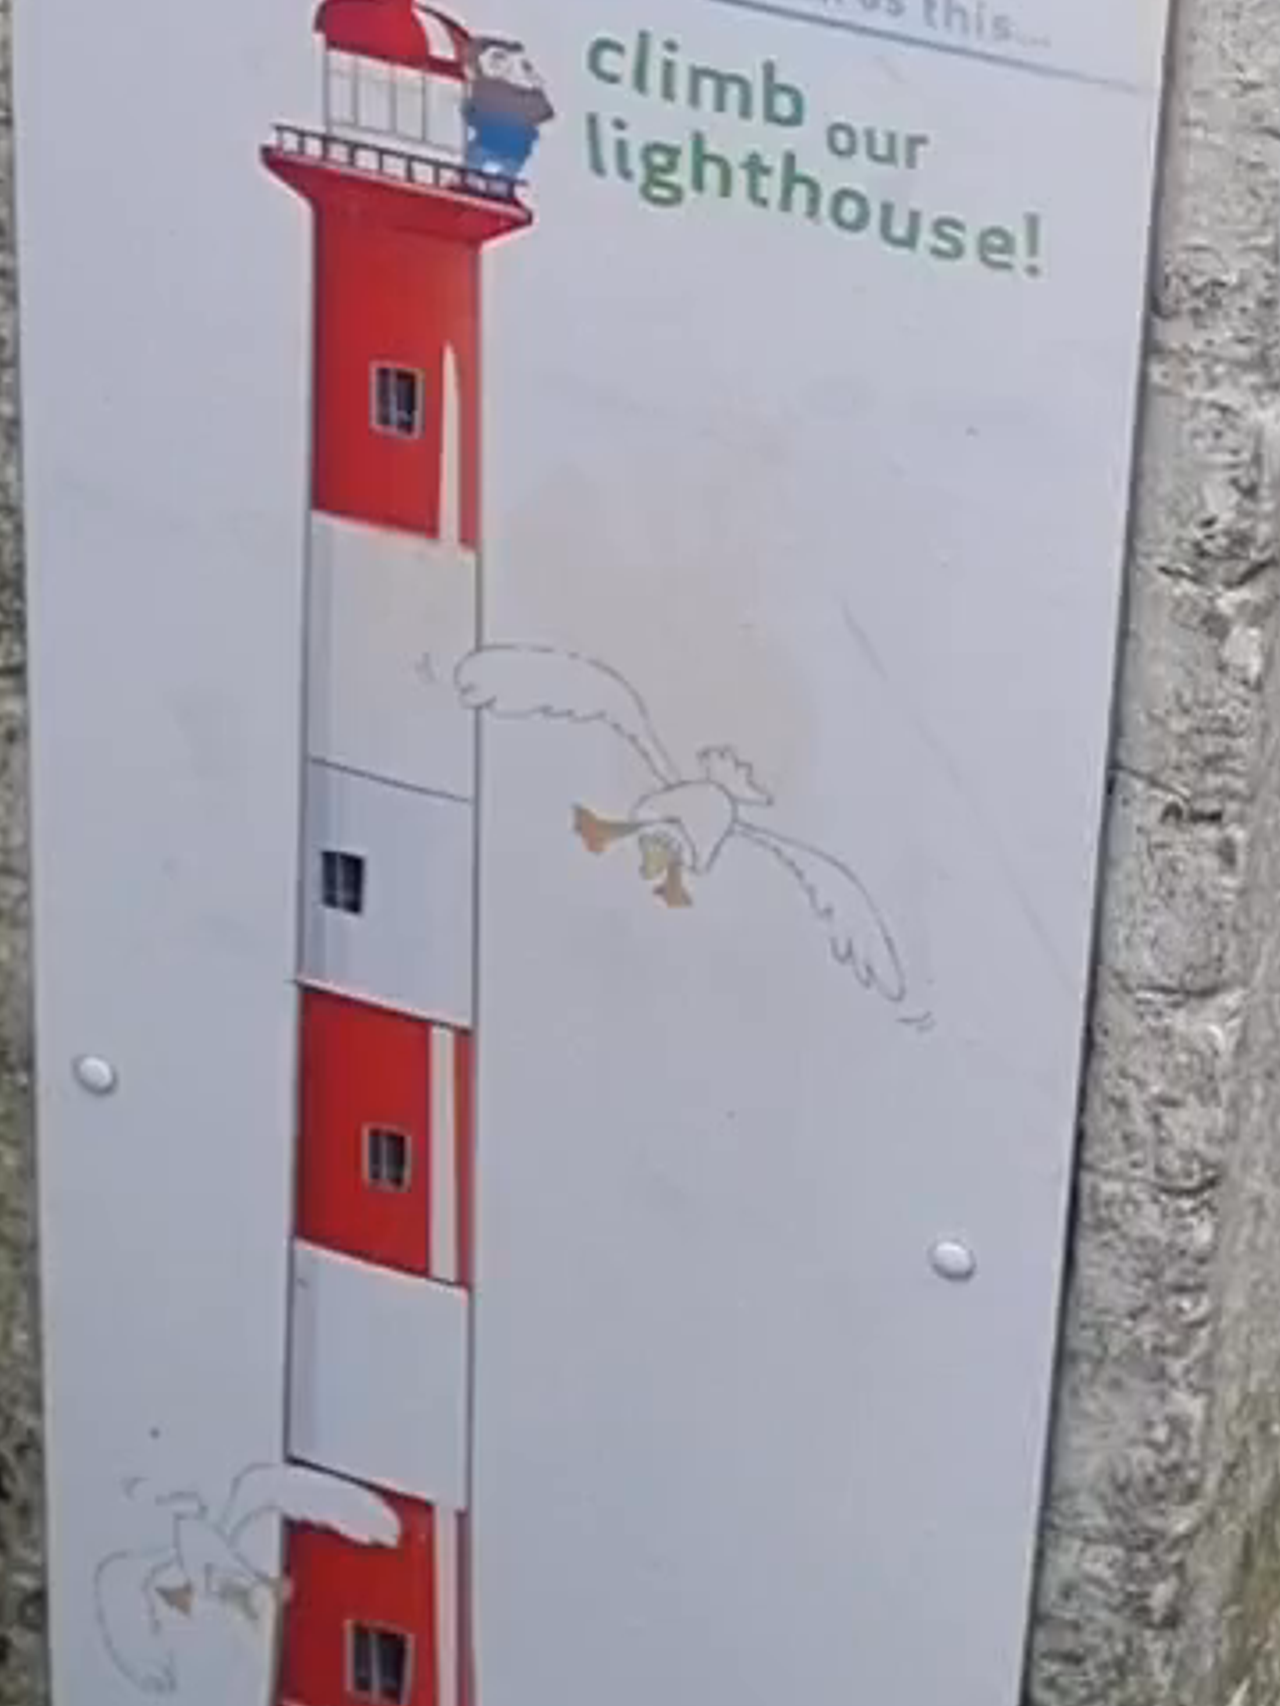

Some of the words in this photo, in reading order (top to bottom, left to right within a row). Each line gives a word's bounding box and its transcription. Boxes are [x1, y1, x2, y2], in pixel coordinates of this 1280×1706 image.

[586, 29, 806, 129] climb
[825, 121, 929, 171] our
[585, 111, 1041, 278] lighthouse!
